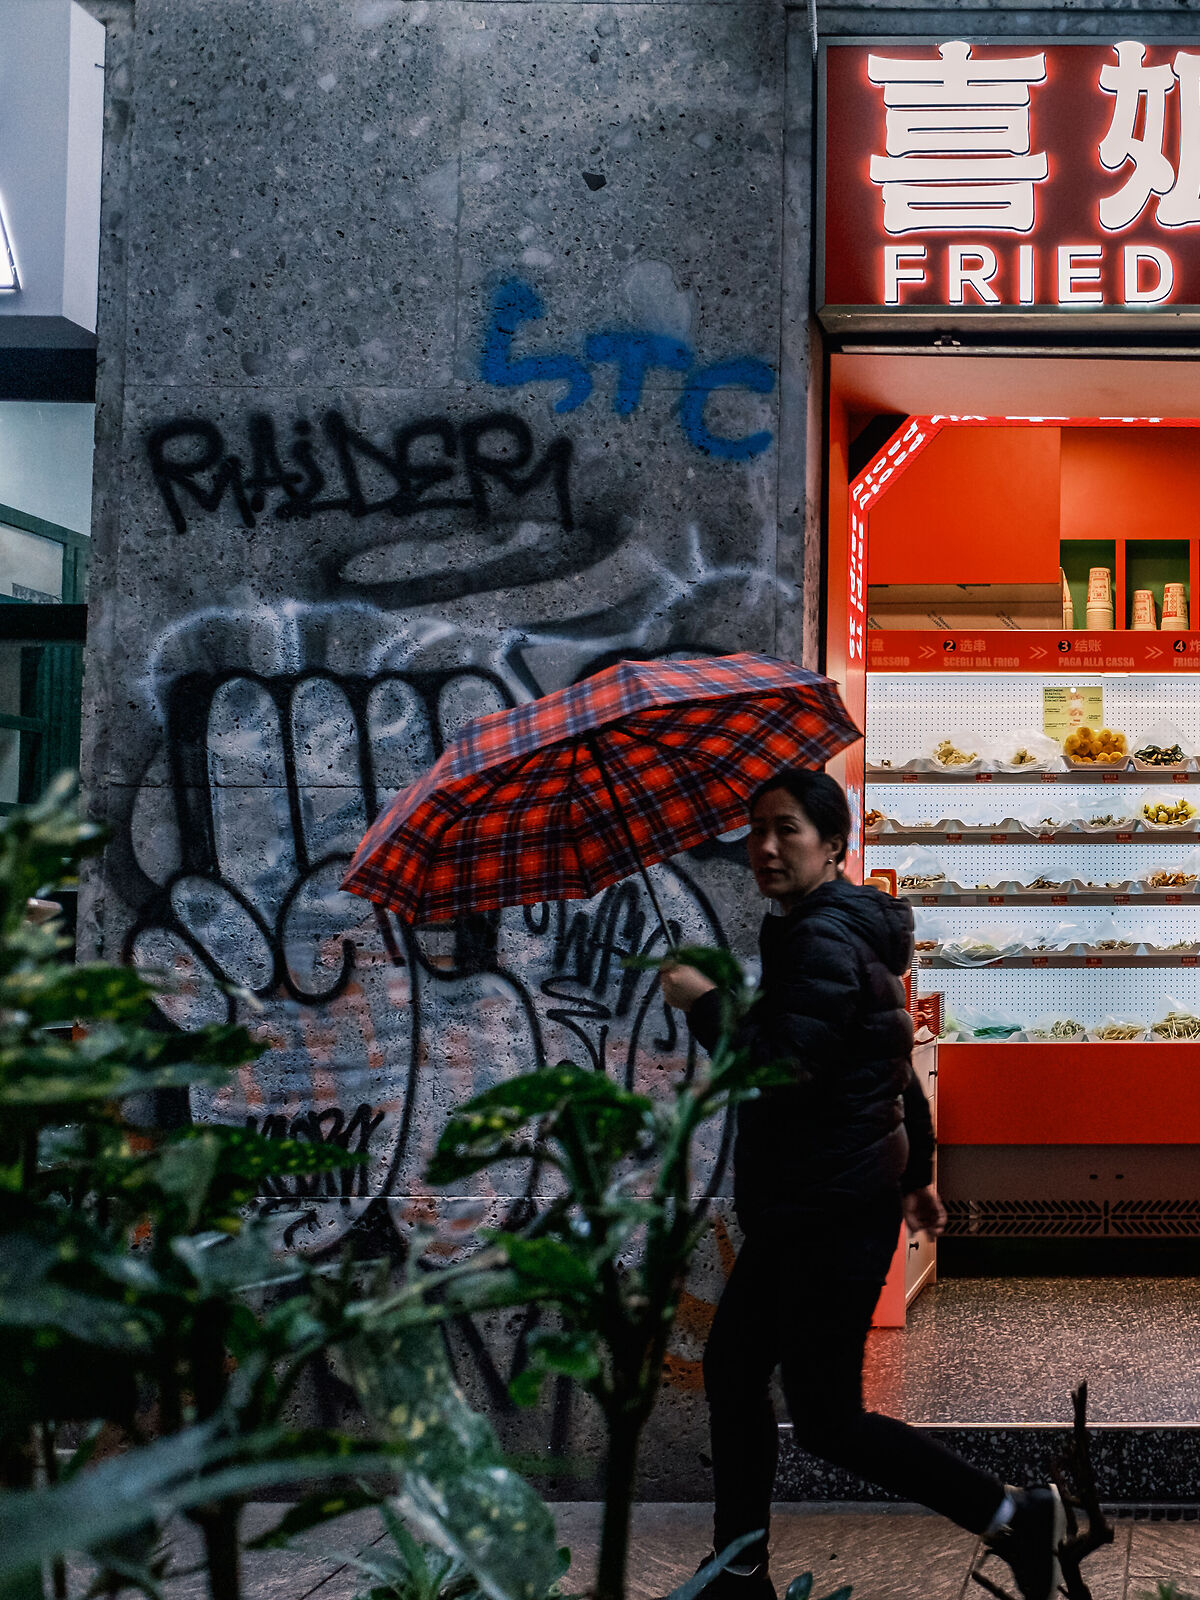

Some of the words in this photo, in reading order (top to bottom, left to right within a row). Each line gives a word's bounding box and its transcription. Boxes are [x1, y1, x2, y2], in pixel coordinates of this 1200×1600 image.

[884, 245, 1175, 306] FRIED
[944, 640, 955, 652] 2
[960, 639, 986, 653] 选串
[1059, 640, 1070, 652] 3
[1074, 639, 1102, 653] 结账
[1174, 640, 1185, 652] 4
[943, 656, 974, 667] SCEGLI
[975, 656, 992, 667] DAL
[993, 657, 1020, 667] FRIGO
[1058, 656, 1082, 667] PAGA
[1083, 656, 1104, 667] ALLA
[1105, 657, 1135, 667] CASSA
